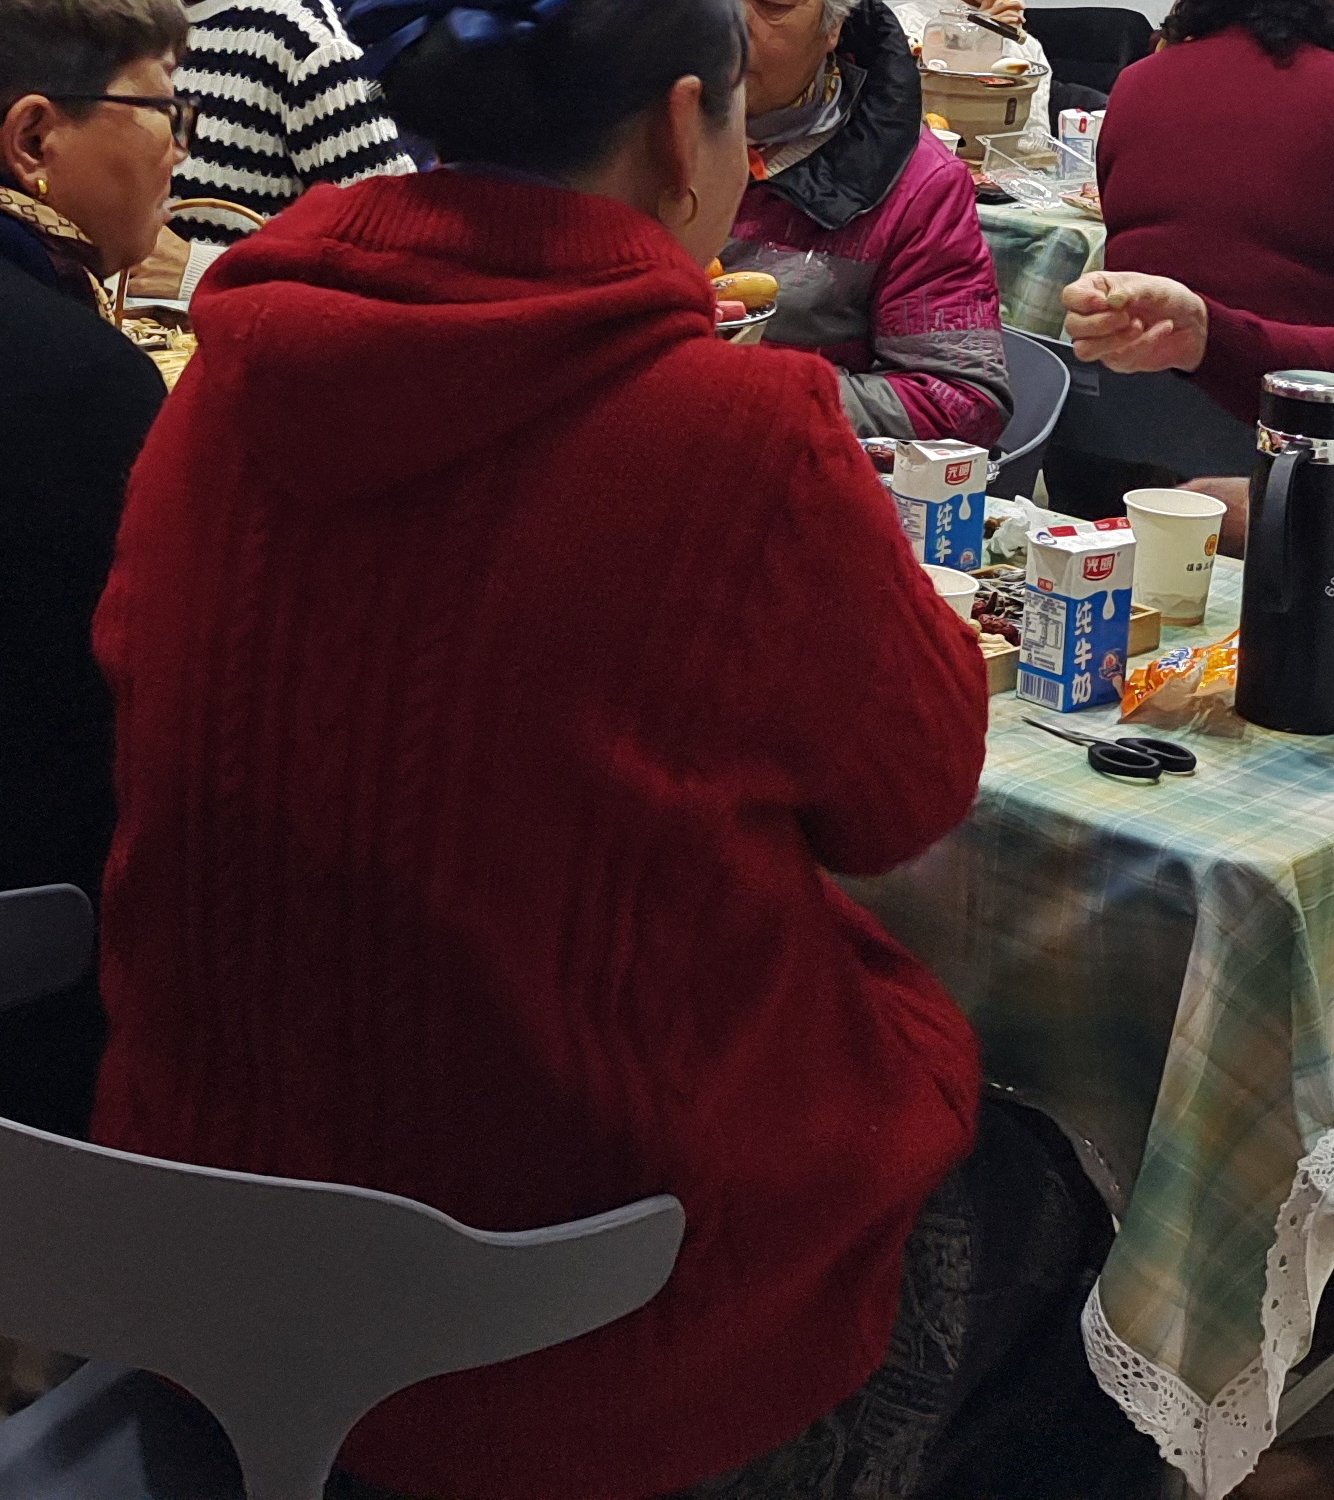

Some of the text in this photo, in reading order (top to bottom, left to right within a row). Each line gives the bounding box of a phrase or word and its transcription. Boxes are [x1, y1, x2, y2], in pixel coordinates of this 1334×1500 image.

[935, 502, 953, 564] 纯牛
[1086, 556, 1113, 574] 光明
[1071, 601, 1093, 706] 纯牛奶
